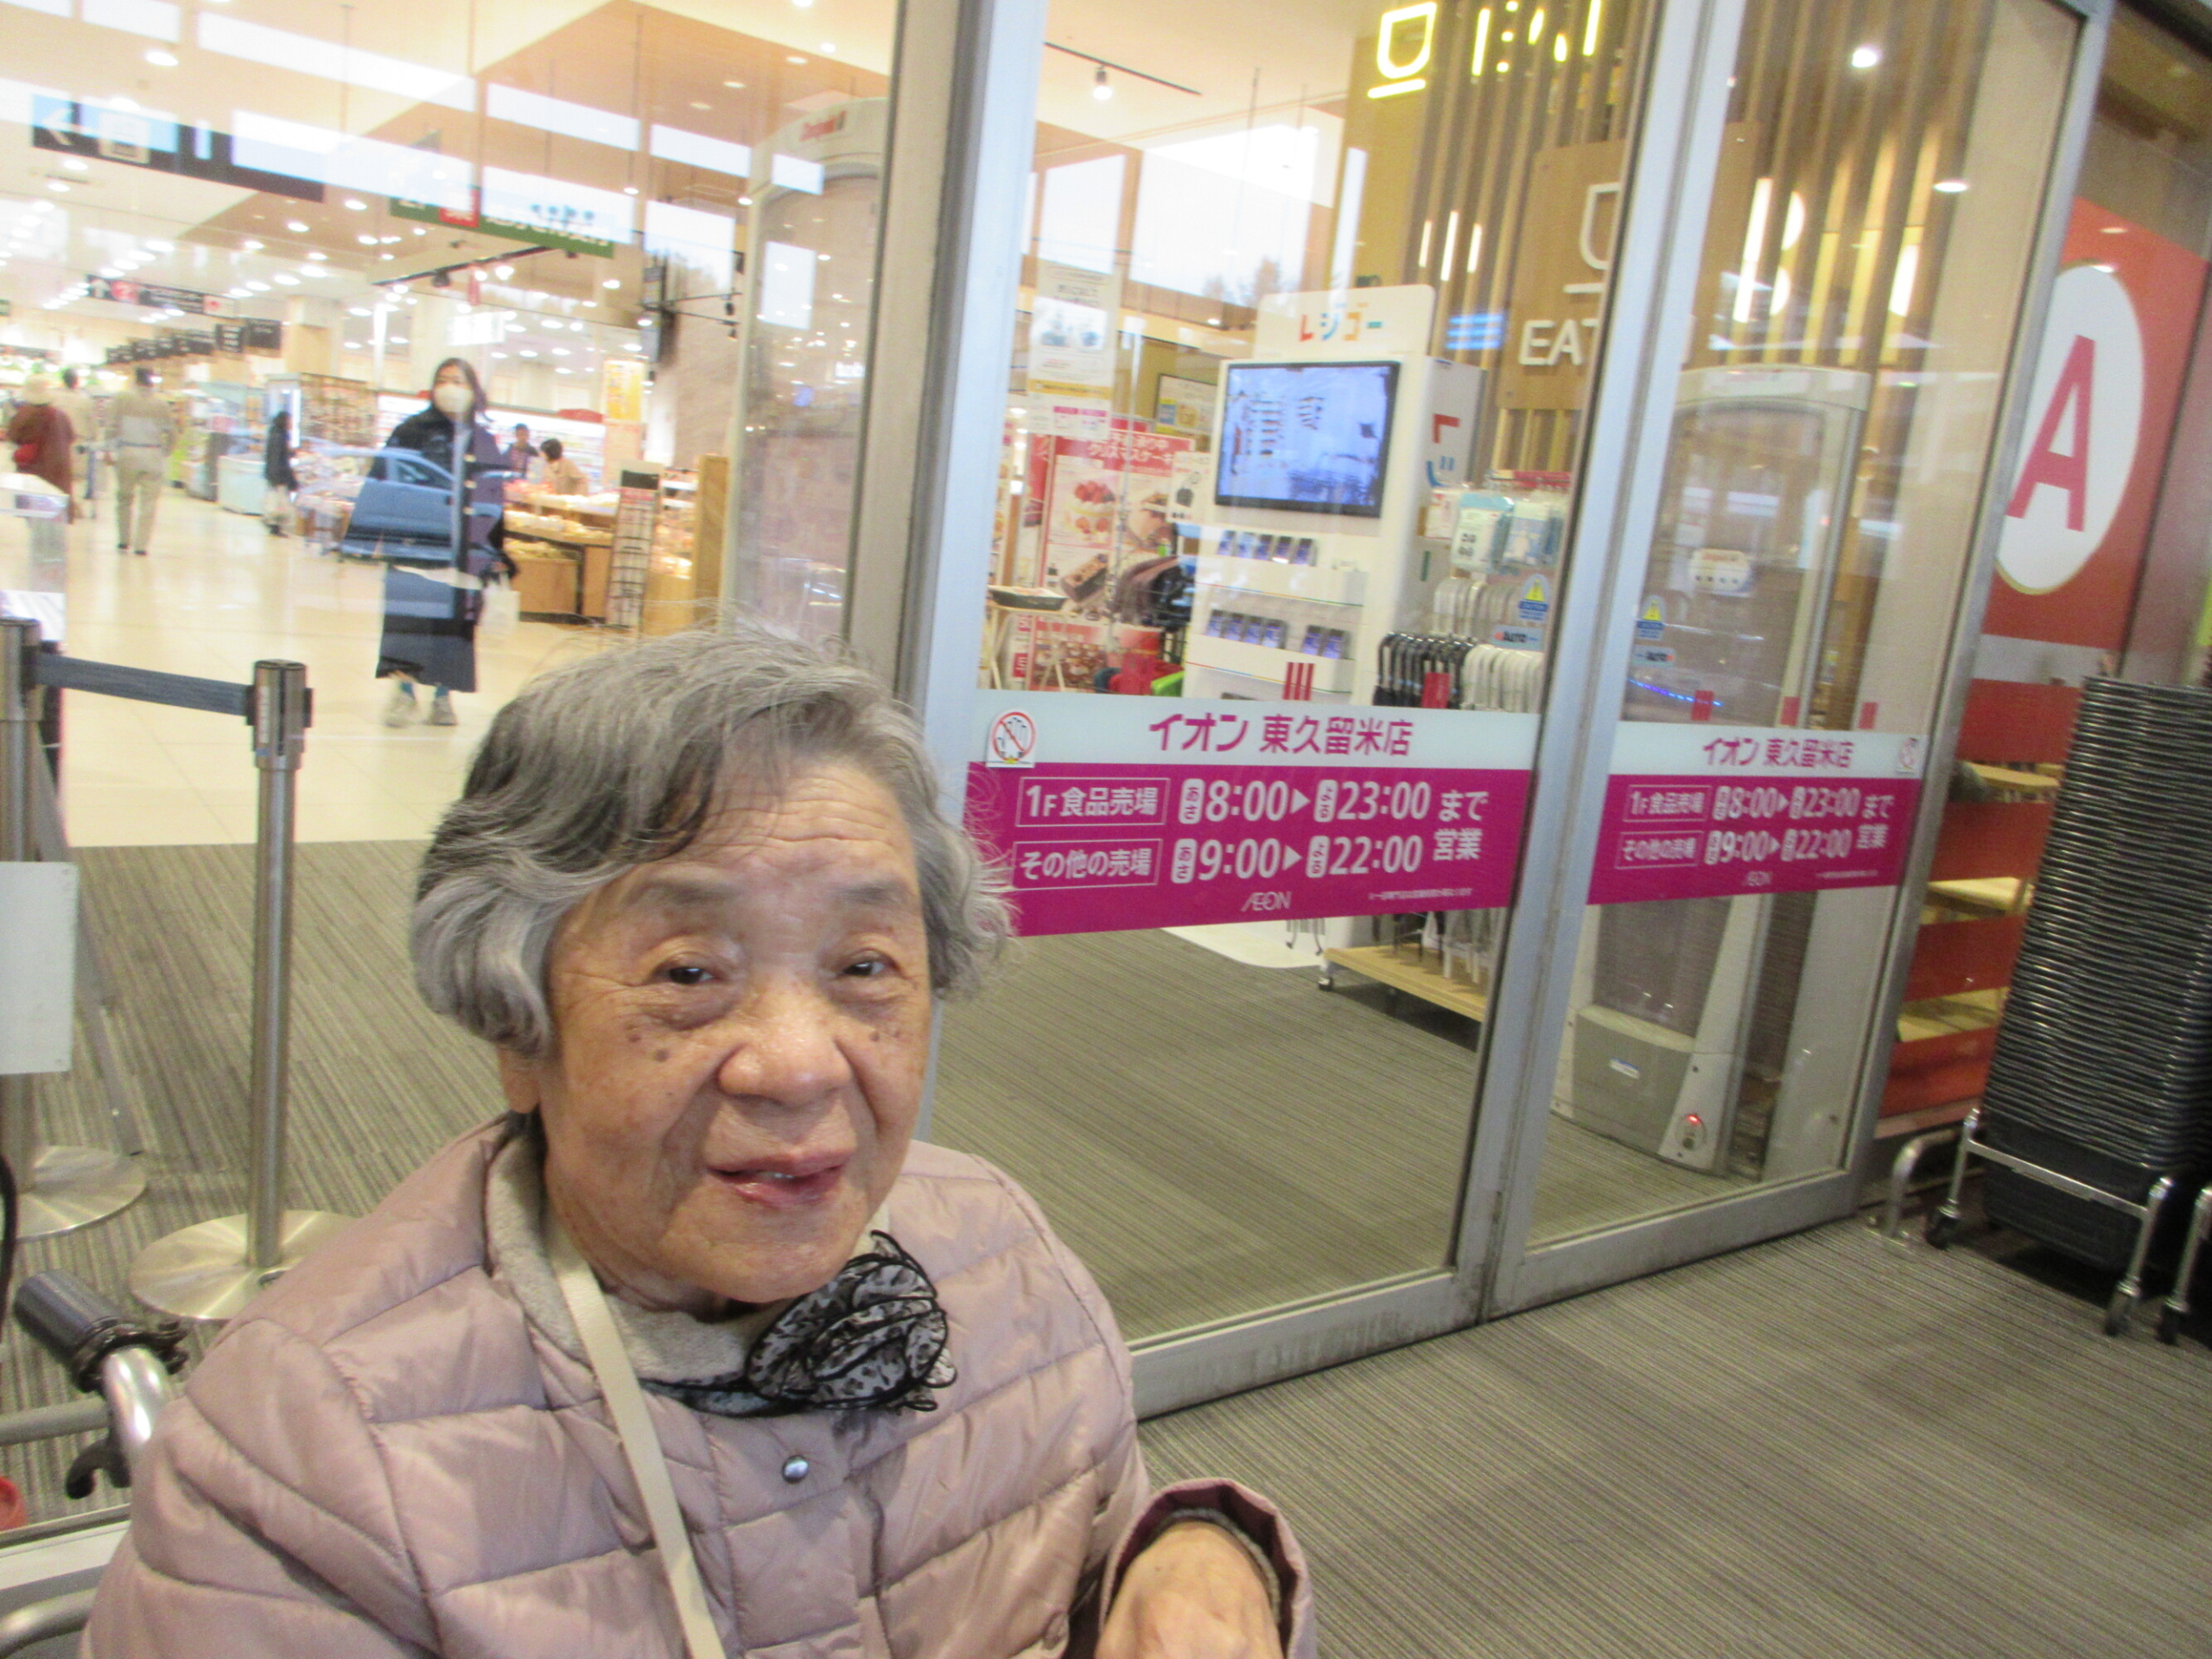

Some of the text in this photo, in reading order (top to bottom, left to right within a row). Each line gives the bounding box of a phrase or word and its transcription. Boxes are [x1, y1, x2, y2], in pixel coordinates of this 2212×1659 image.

[1299, 302, 1382, 341] レジゴー
[2005, 334, 2095, 532] A
[1149, 713, 1414, 756] イオン 東久留米店
[1702, 737, 1759, 766] イオン
[1205, 780, 1289, 822] 8:00
[1337, 781, 1431, 820] 23:00
[1439, 790, 1489, 822] まで
[1020, 848, 1153, 880] その他の売場
[1198, 838, 1281, 880] 9:00
[1329, 835, 1423, 875] 22:00
[1432, 827, 1484, 861] 営業
